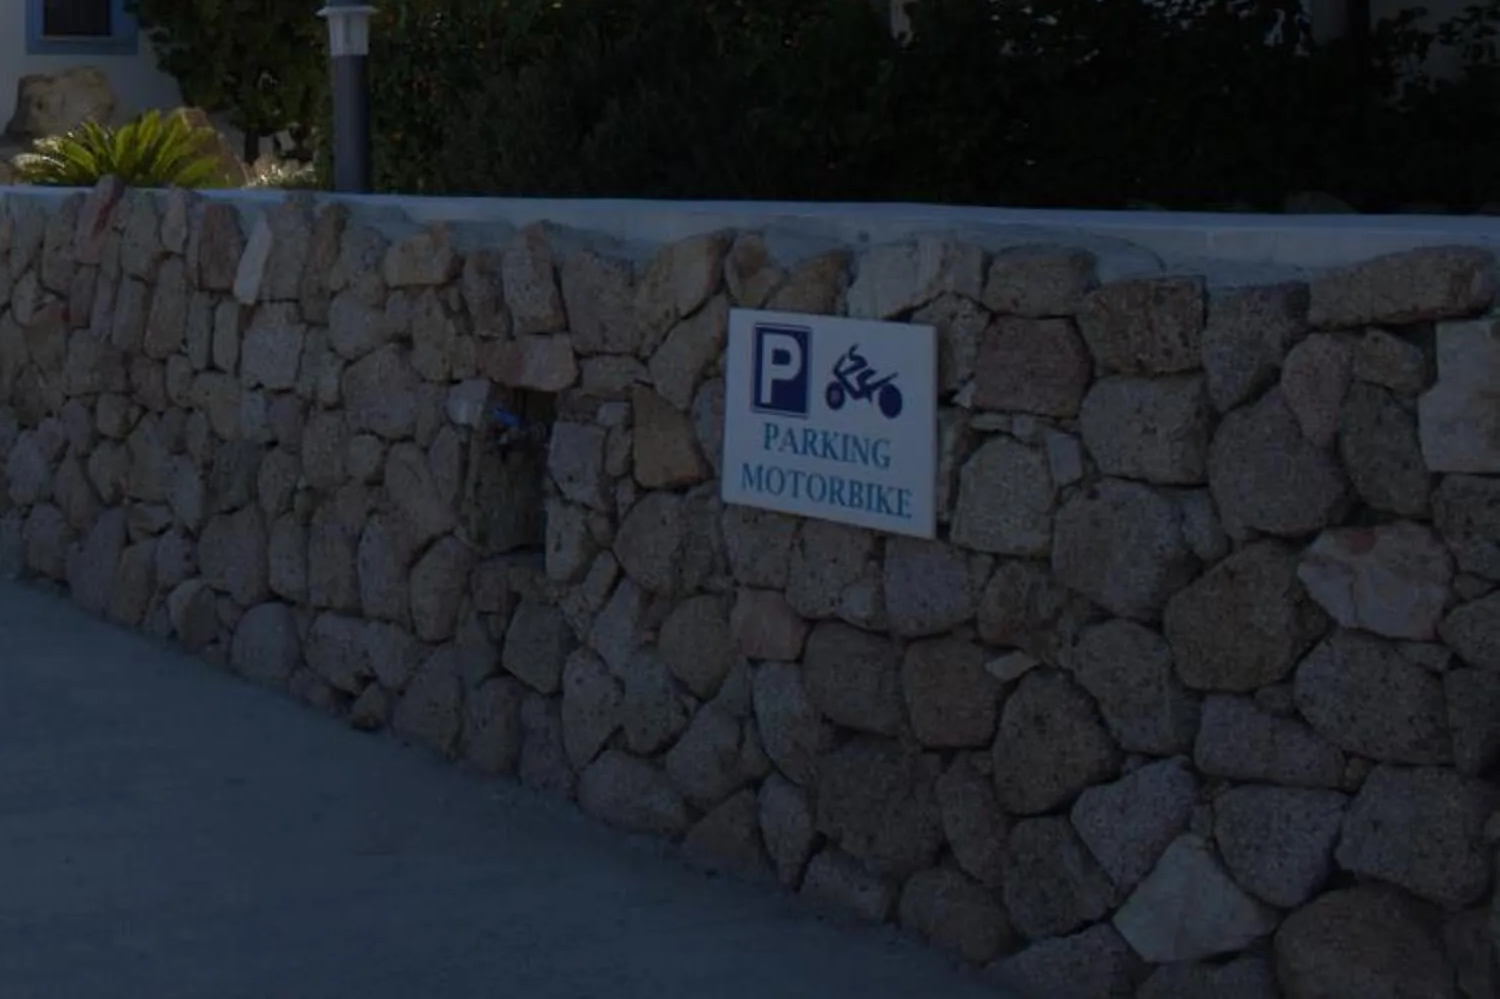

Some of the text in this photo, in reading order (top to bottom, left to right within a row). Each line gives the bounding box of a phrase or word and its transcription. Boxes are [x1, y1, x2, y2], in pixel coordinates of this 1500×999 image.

[761, 332, 803, 404] P
[763, 422, 892, 469] PARKING
[741, 463, 913, 518] MOTORBIKE
